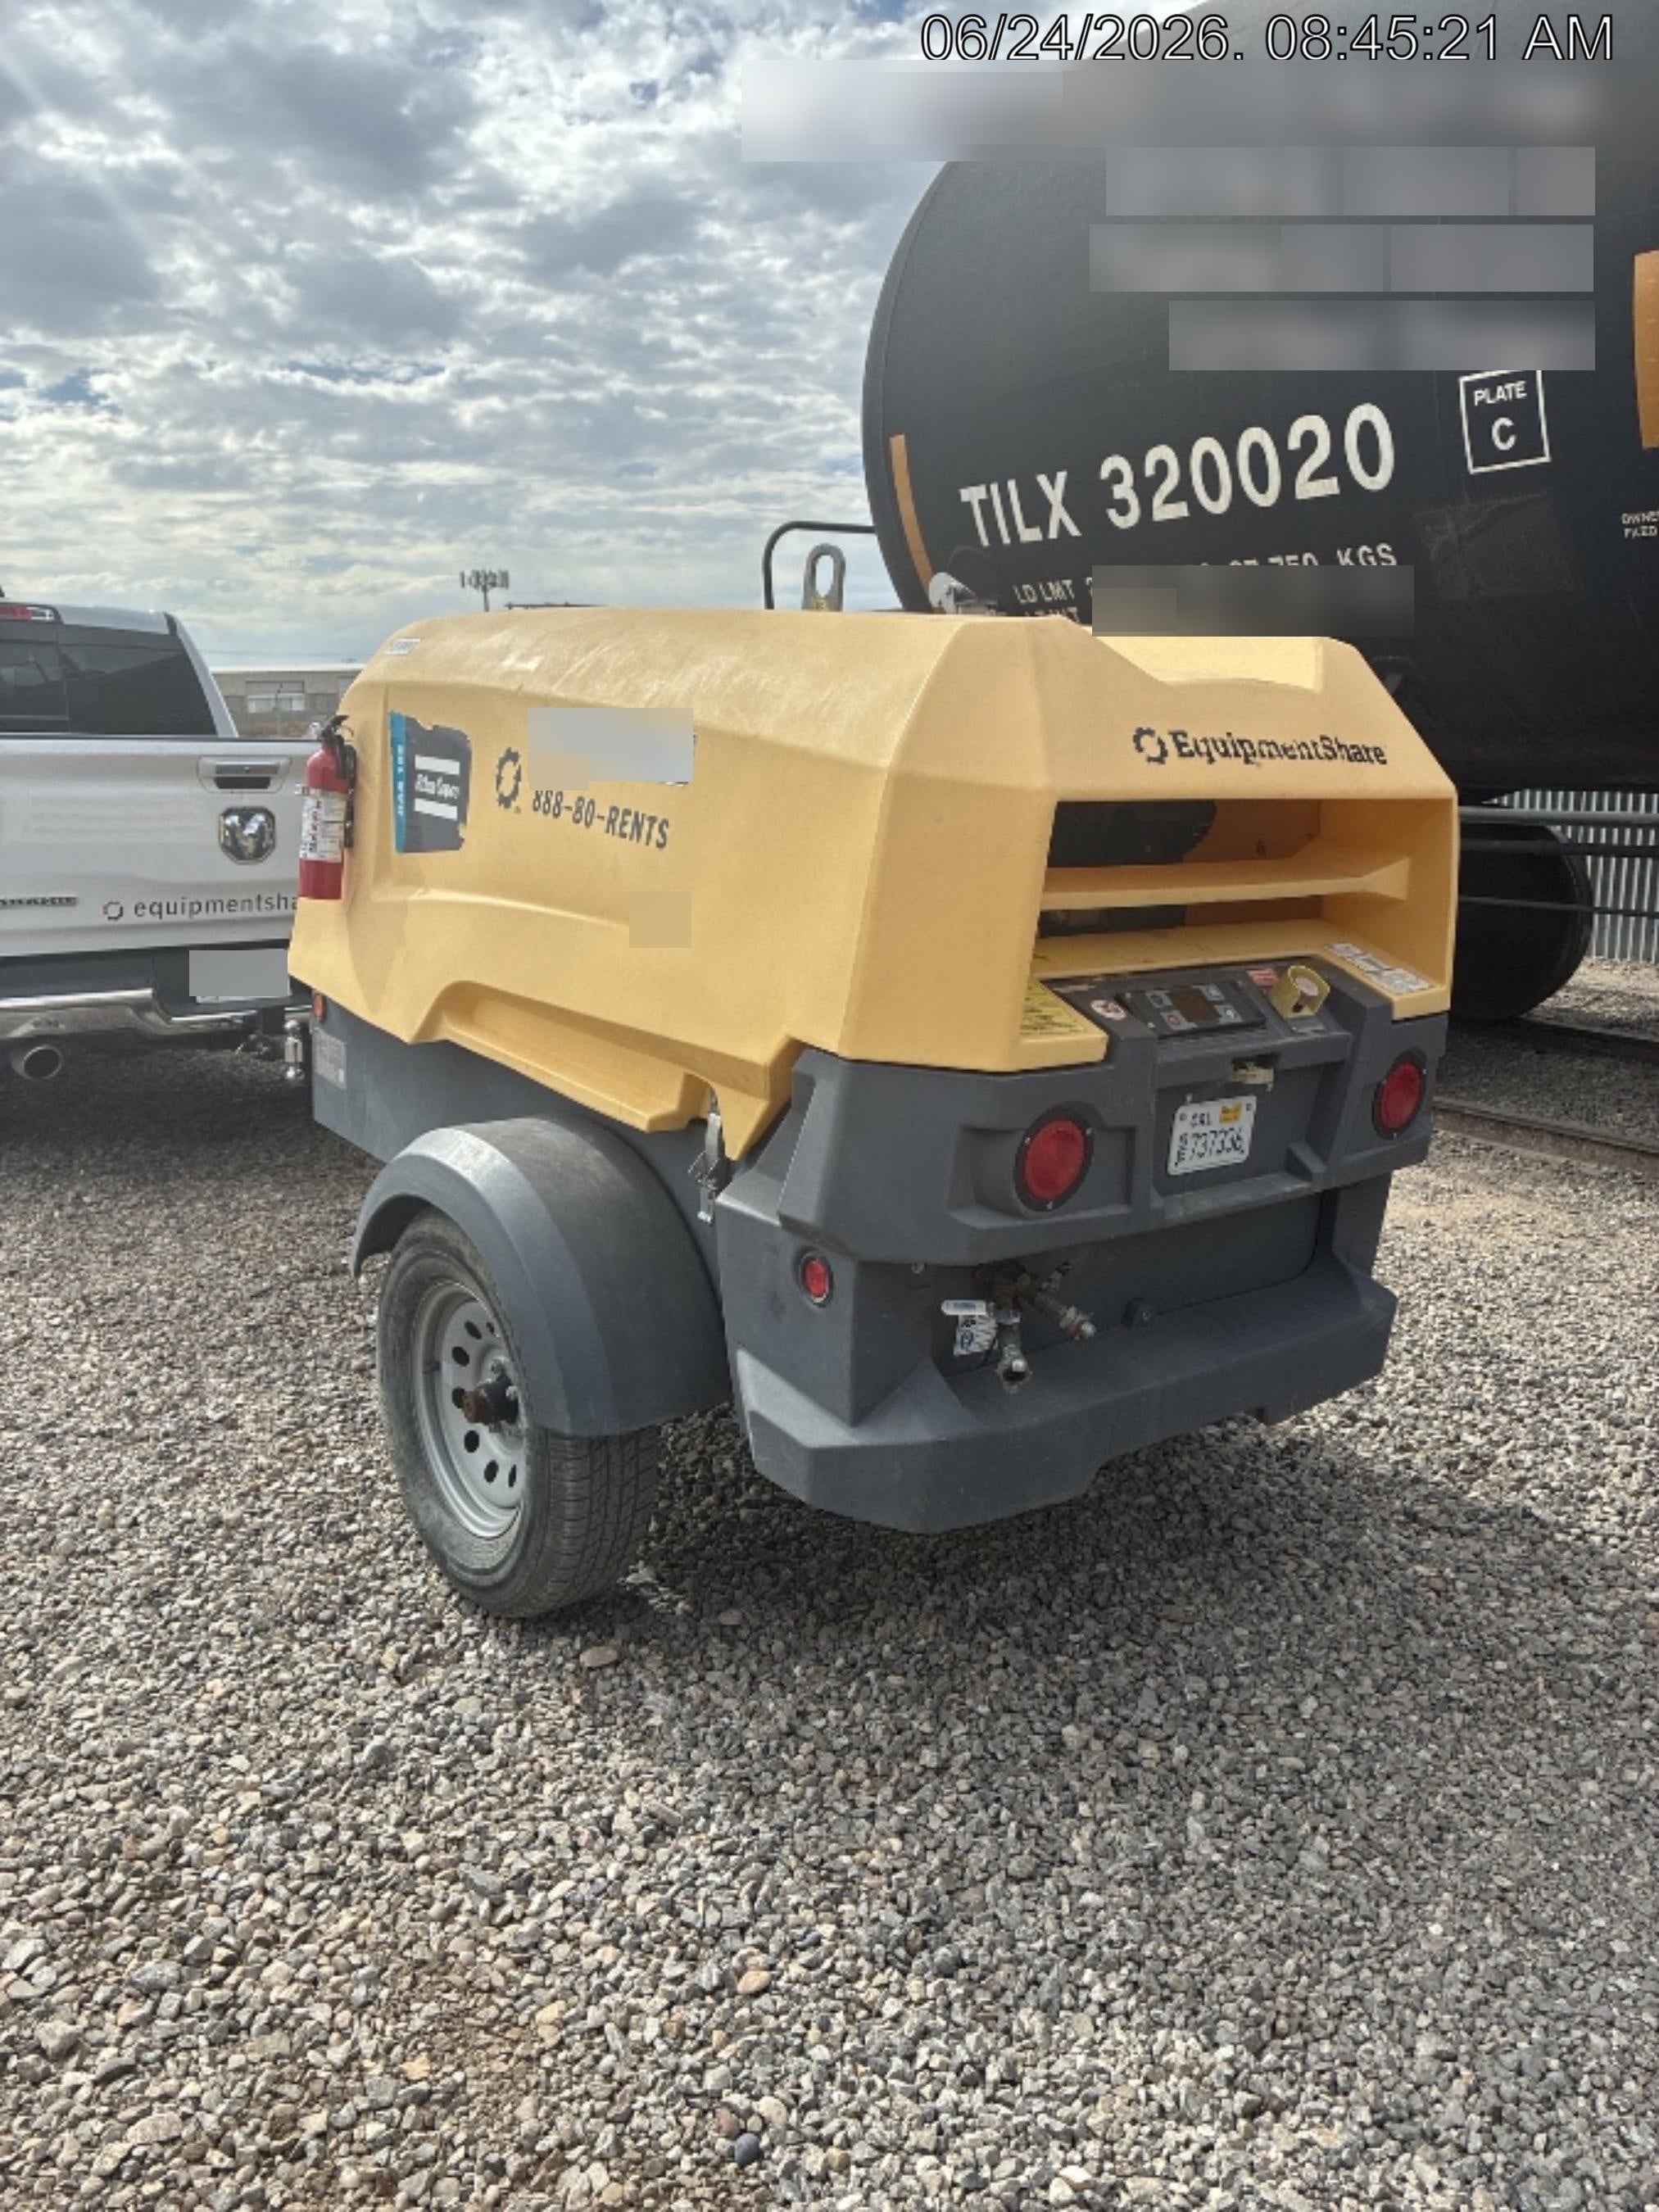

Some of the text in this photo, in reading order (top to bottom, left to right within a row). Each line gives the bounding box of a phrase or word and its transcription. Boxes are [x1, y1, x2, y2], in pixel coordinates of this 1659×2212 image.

[1474, 380, 1527, 406] PLATE
[1492, 416, 1516, 451] C
[959, 401, 1394, 547] TILX 320020
[1337, 542, 1398, 566] KGS
[1013, 584, 1037, 605] LD
[1167, 728, 1388, 765] EquipmentShare
[532, 790, 669, 850] 888-80-RENTS
